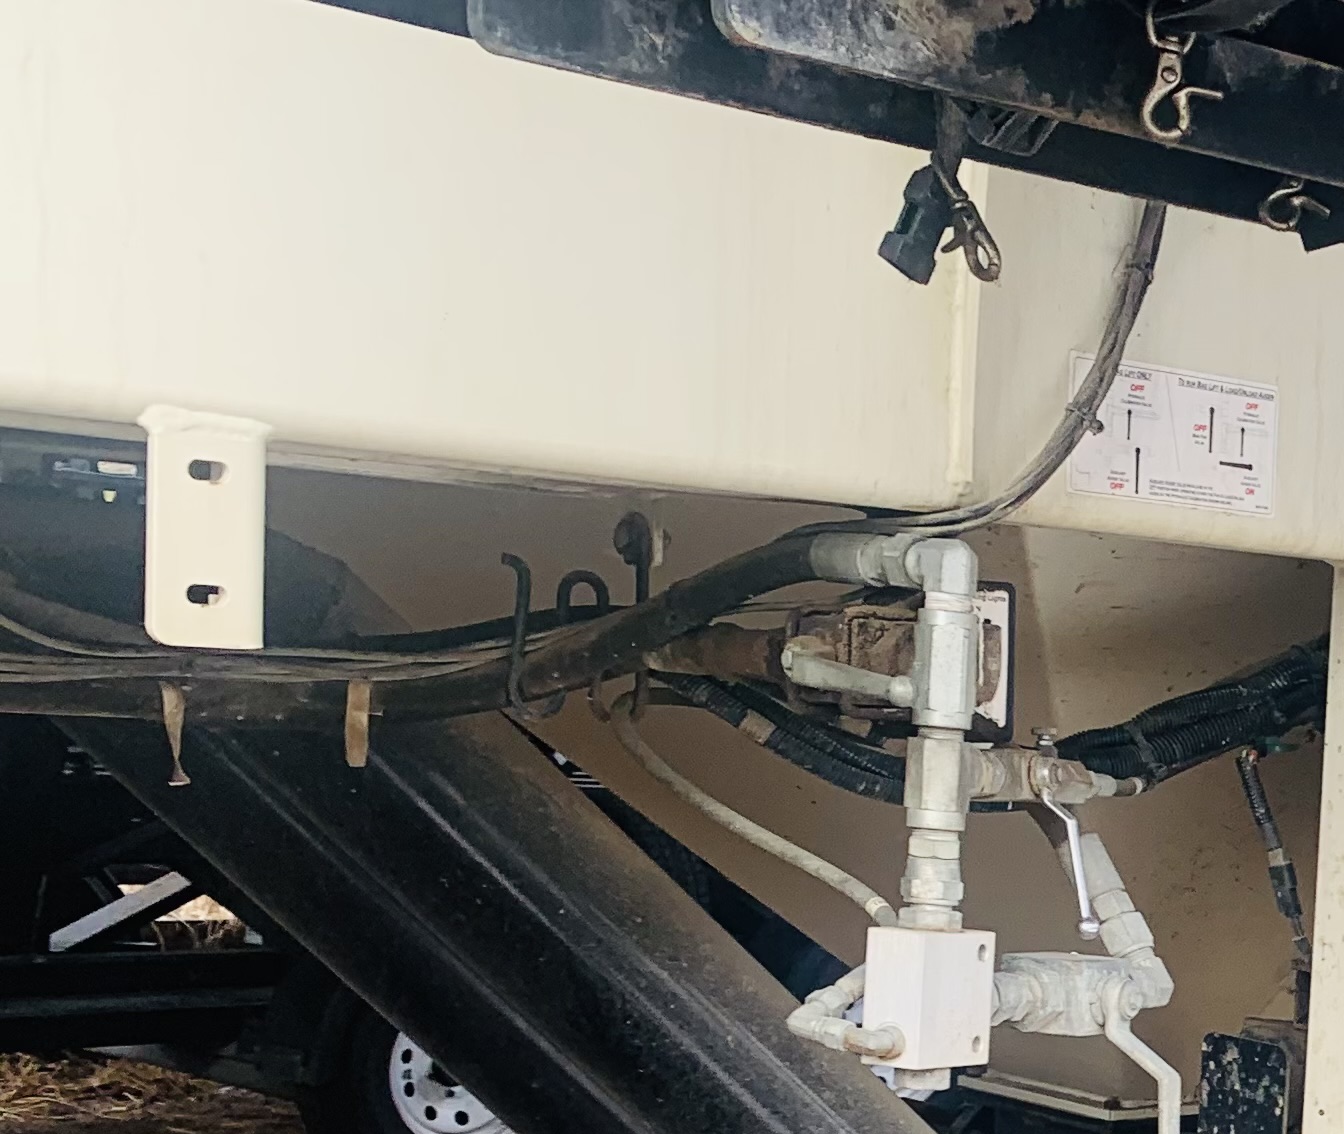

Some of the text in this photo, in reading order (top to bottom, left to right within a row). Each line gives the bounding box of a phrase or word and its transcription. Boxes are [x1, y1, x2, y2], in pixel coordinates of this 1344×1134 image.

[1130, 384, 1145, 392] OFF
[1245, 402, 1259, 411] OFF
[1193, 424, 1207, 432] OFF
[1110, 482, 1125, 491] OFF
